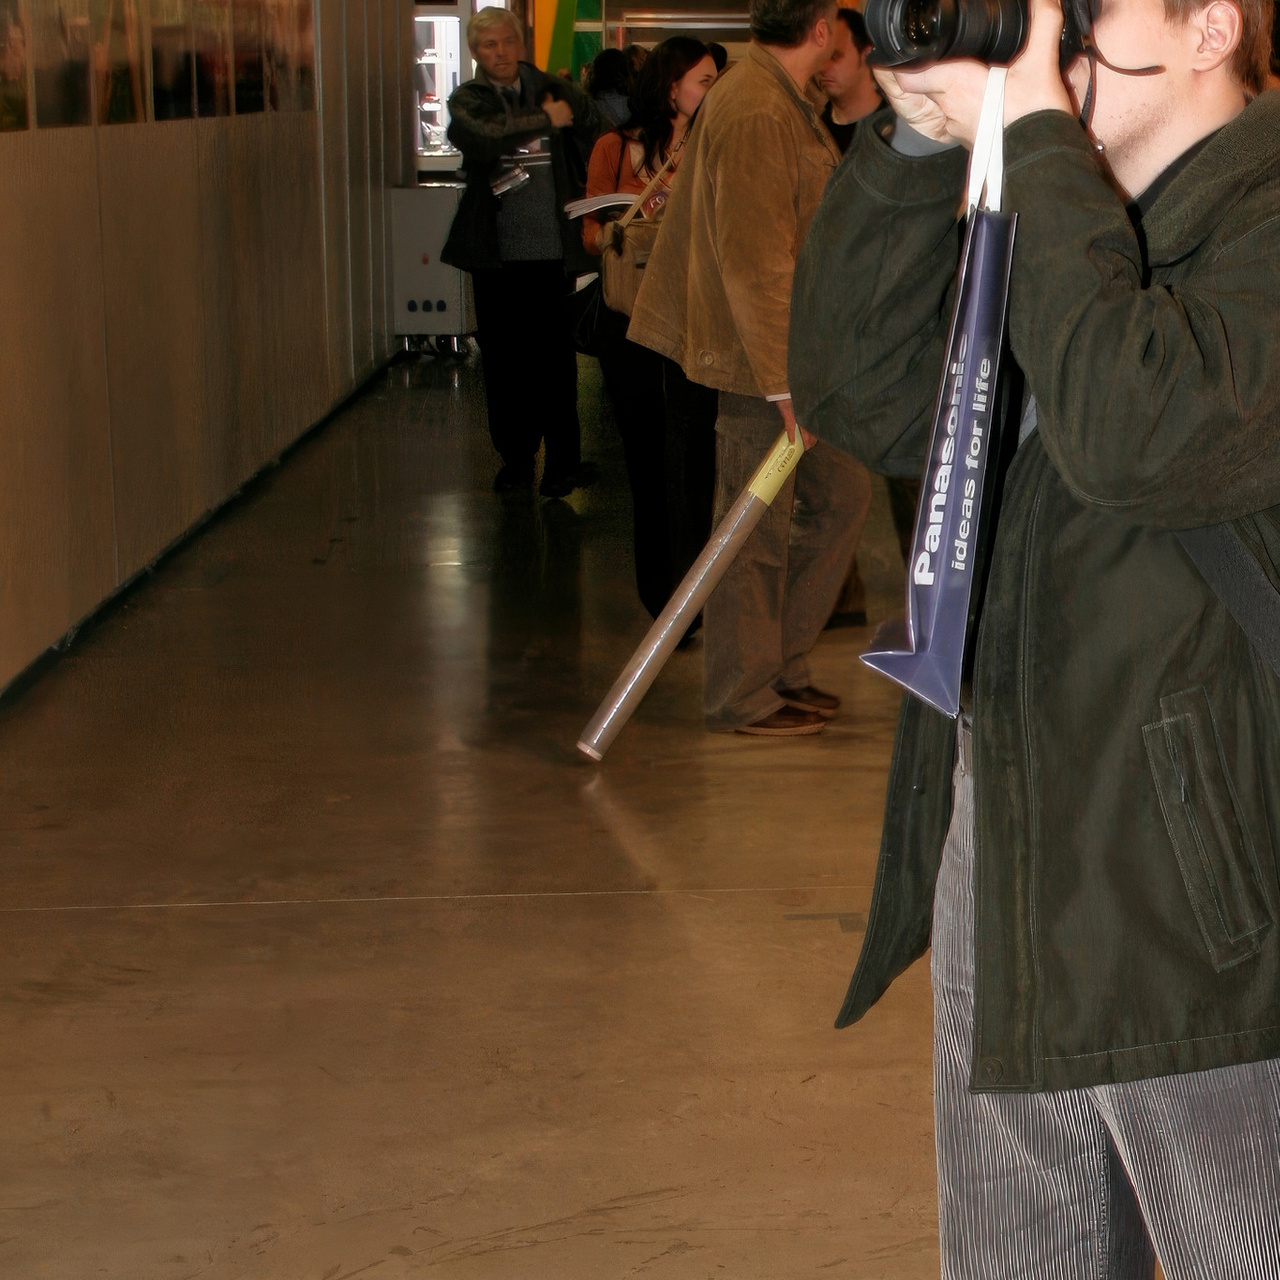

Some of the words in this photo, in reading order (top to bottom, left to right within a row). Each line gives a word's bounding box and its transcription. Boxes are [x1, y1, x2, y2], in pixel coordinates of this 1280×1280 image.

[973, 358, 992, 412] life
[914, 333, 968, 586] Panasonic
[965, 420, 984, 470] for
[952, 478, 976, 570] ideas
